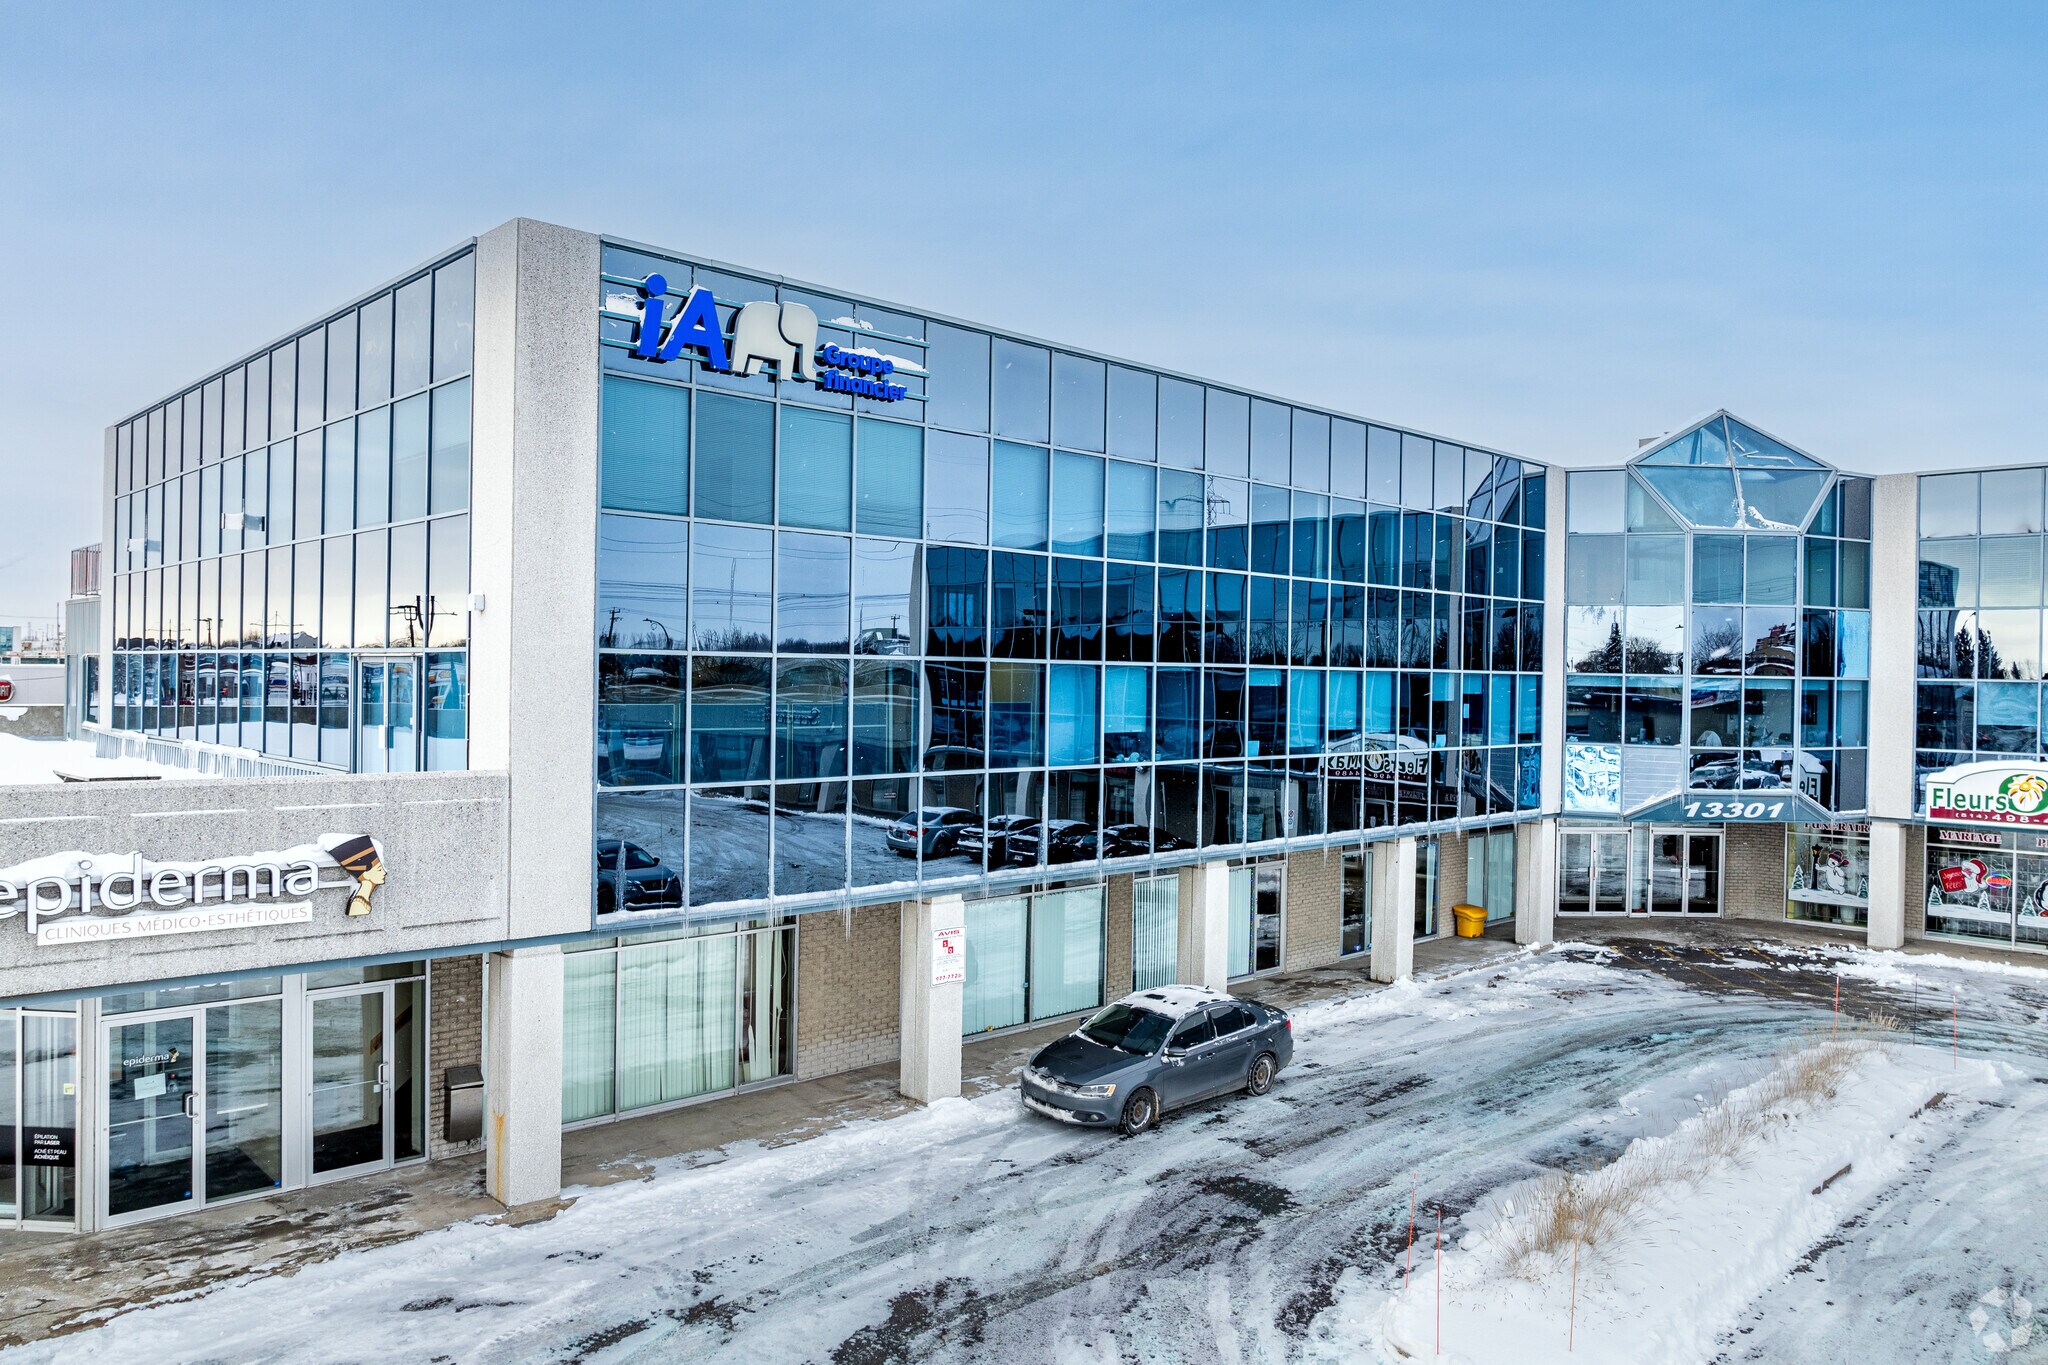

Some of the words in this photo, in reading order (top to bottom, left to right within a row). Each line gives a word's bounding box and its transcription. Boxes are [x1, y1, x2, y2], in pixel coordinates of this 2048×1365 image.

[823, 345, 894, 376] Groupe
[823, 370, 908, 401] financier
[1932, 787, 2007, 811] Fleurs
[1683, 801, 1786, 819] 13301
[1940, 830, 2002, 844] MARIAGE
[45, 921, 132, 941] CLINIQUES
[123, 1053, 170, 1067] epiderma
